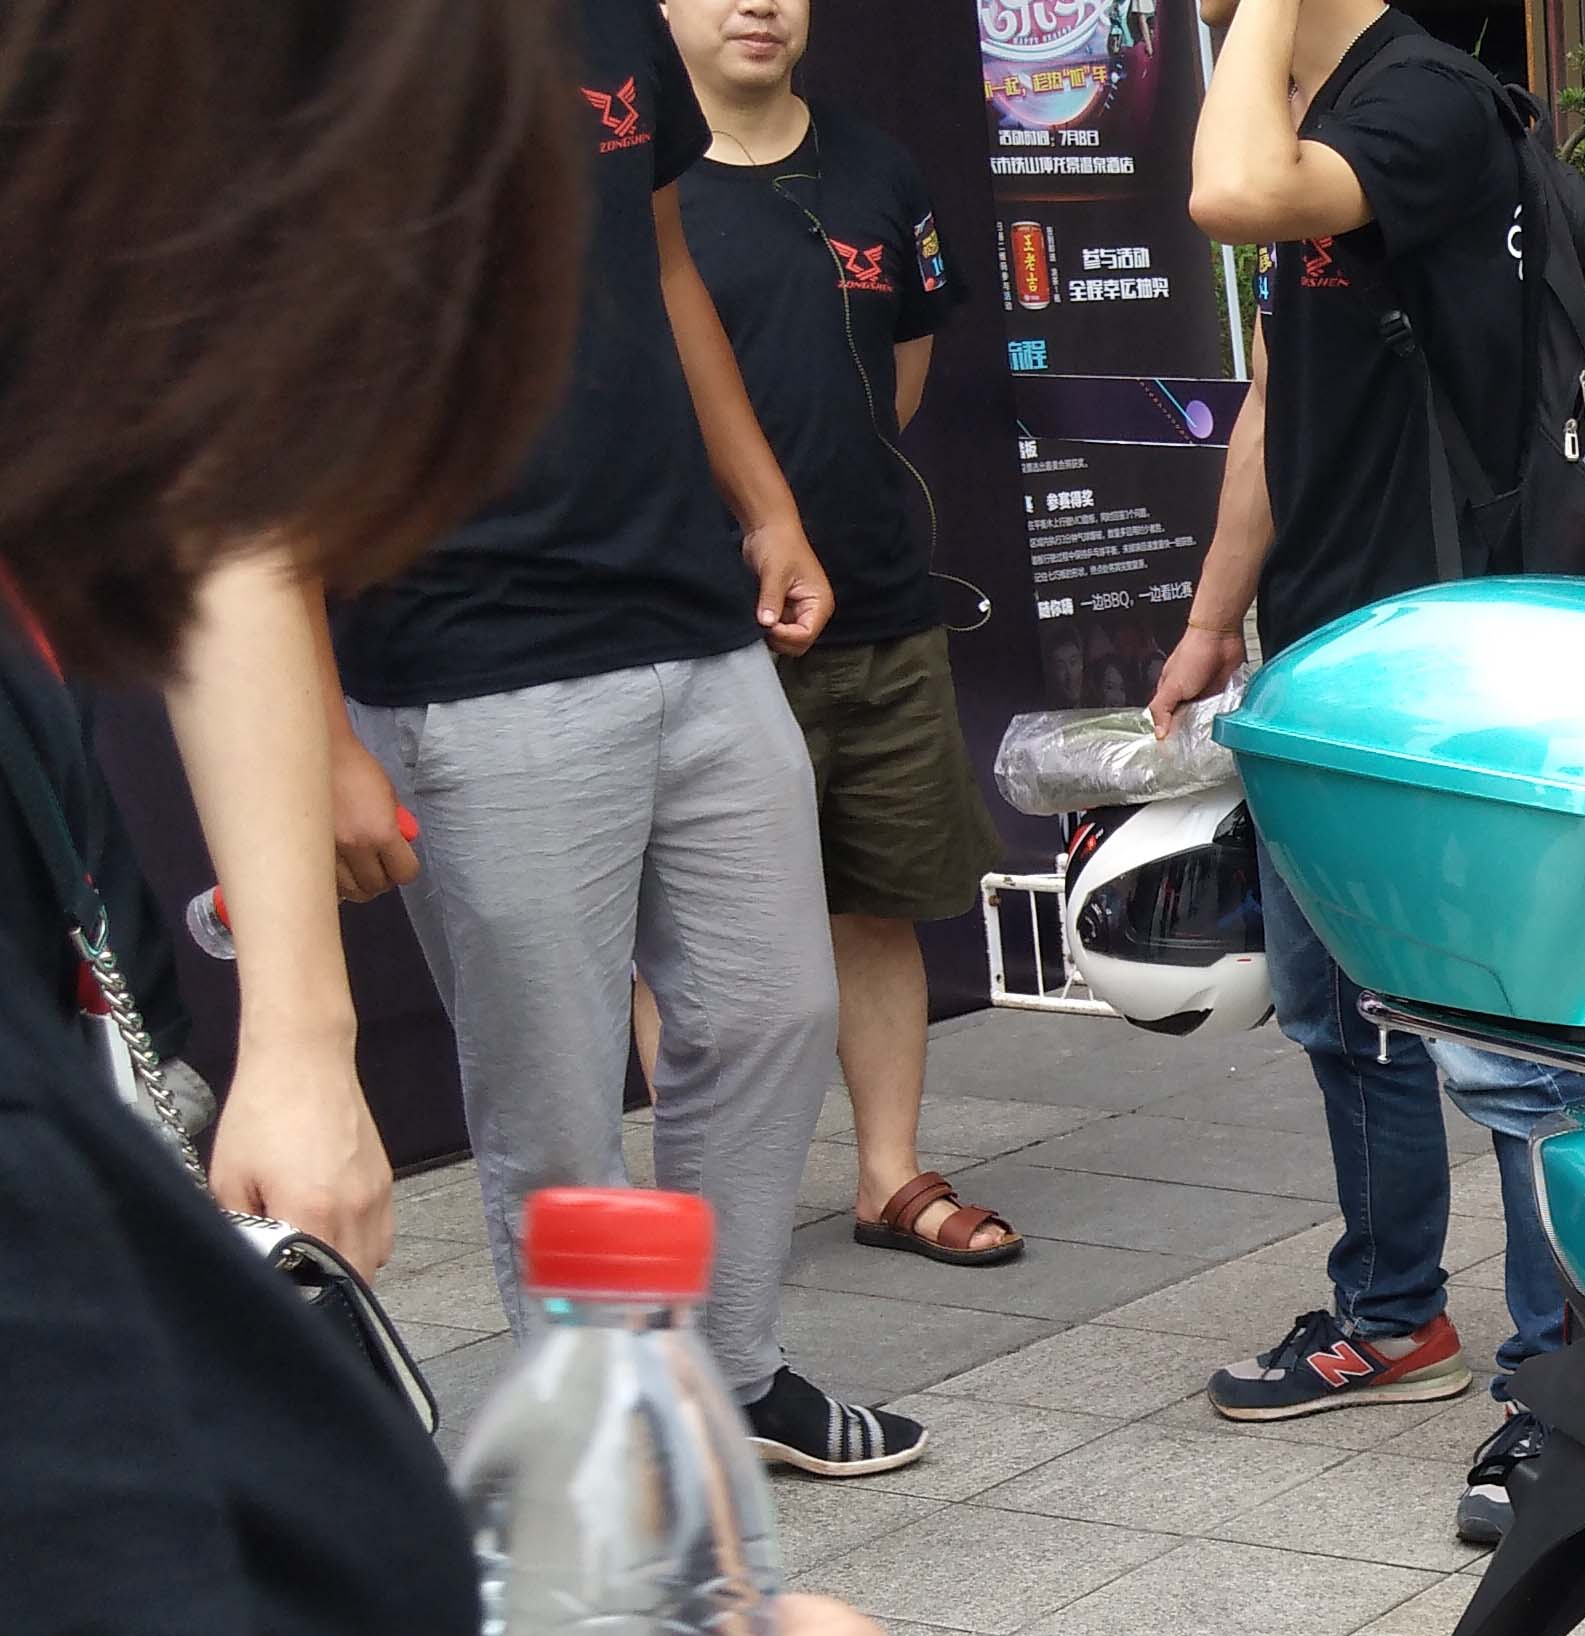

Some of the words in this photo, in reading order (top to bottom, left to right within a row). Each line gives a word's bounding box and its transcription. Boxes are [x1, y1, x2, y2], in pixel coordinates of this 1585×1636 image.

[1083, 247, 1151, 270] 参与活动
[1069, 277, 1170, 302] 全程幸运抽奖
